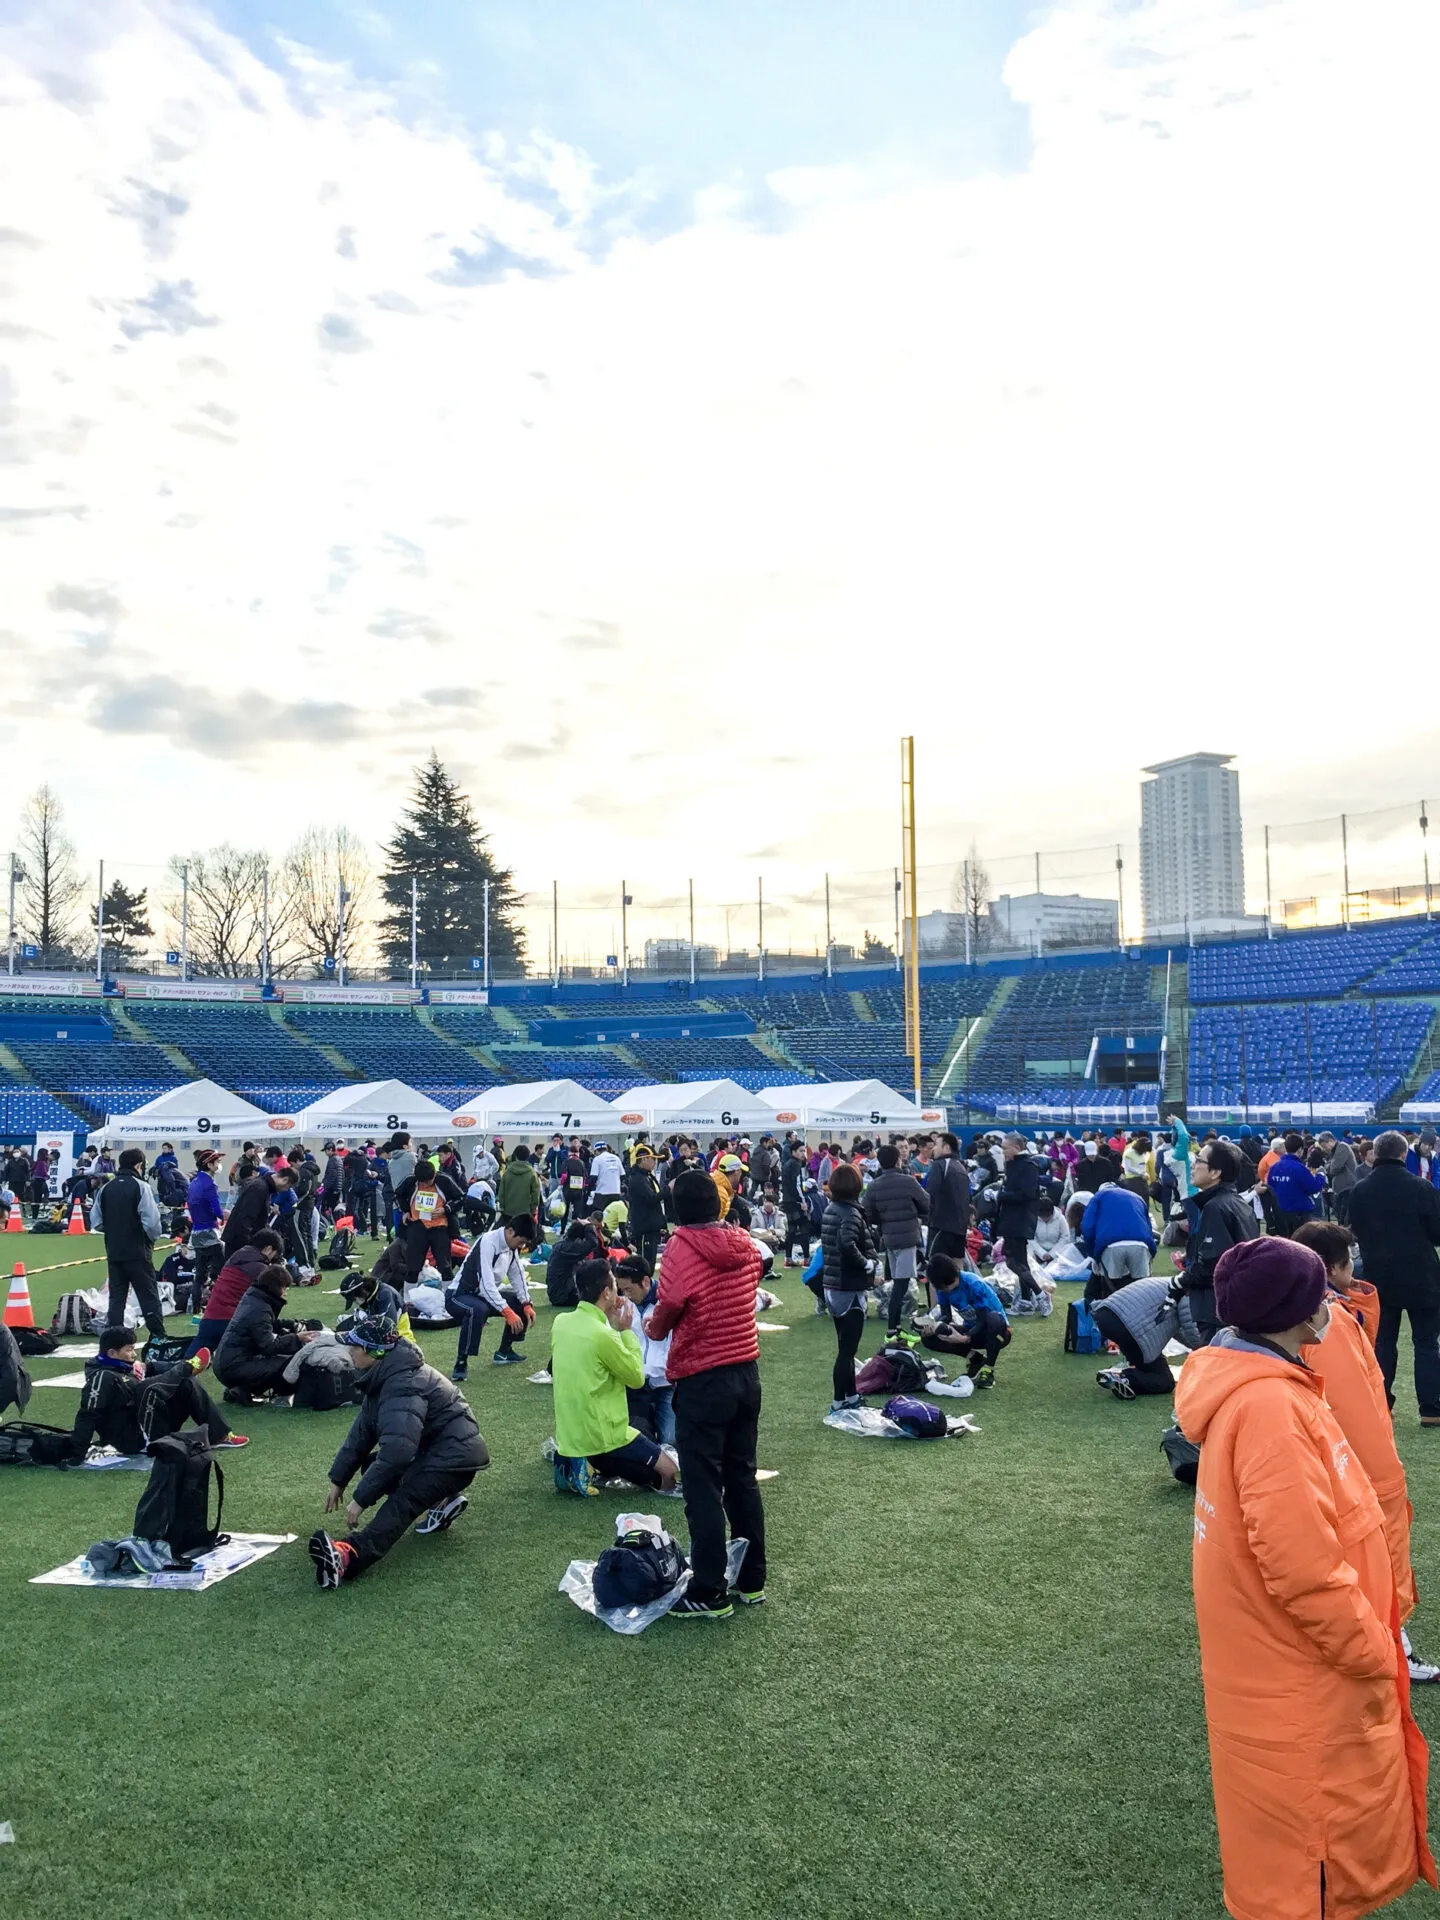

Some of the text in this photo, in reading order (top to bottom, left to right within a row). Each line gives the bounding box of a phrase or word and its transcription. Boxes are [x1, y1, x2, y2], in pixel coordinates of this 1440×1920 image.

[25, 946, 34, 956] E
[168, 953, 177, 962] D
[608, 956, 616, 965] A
[325, 958, 334, 968] C
[473, 959, 480, 968] B
[197, 1117, 220, 1133] 9番
